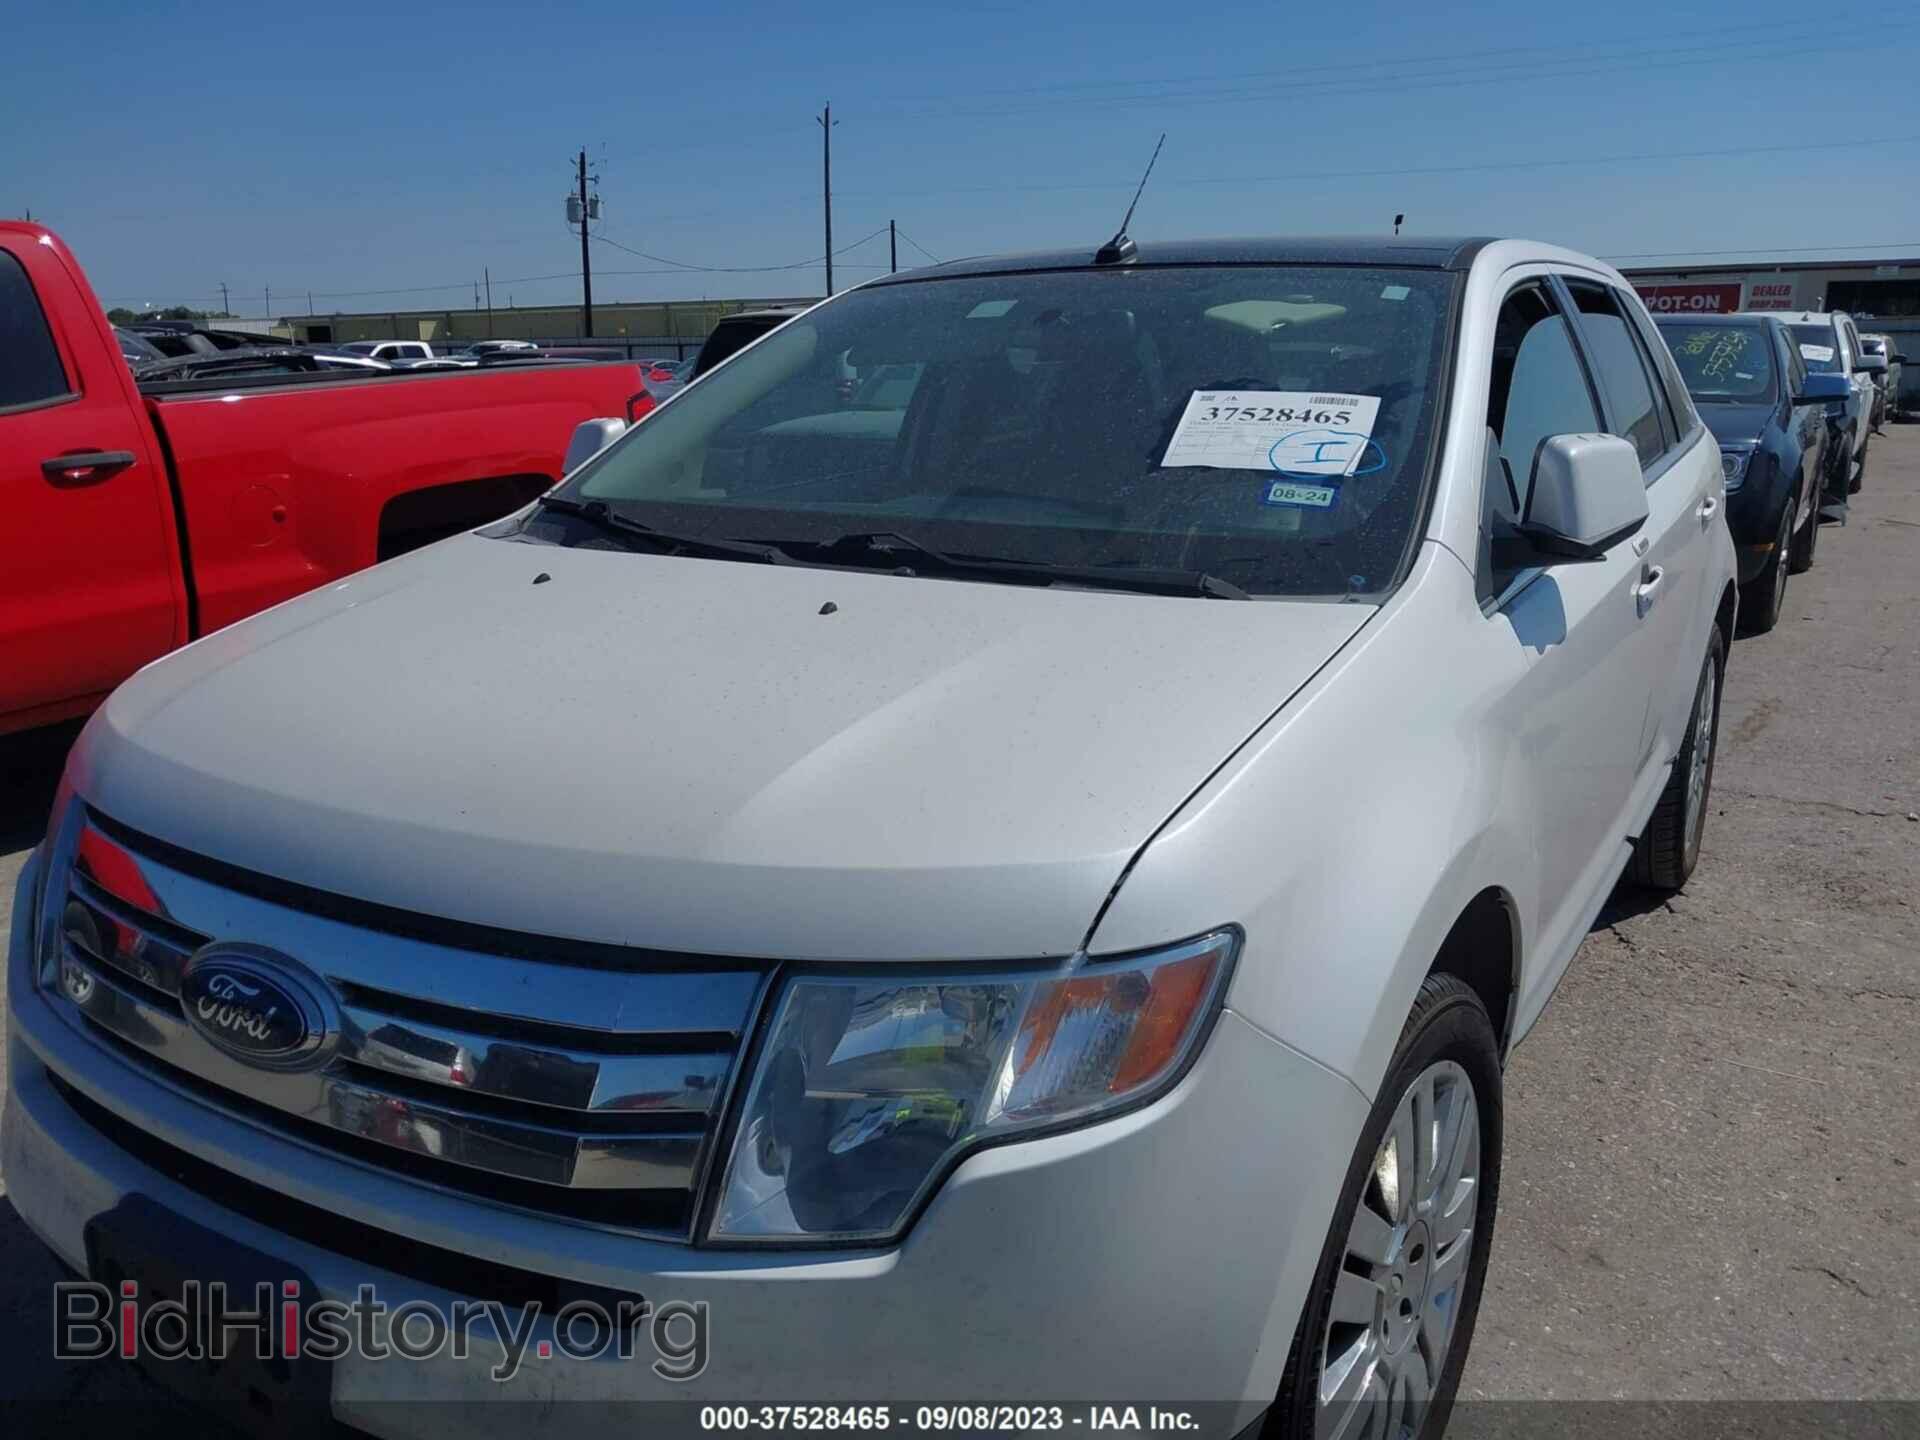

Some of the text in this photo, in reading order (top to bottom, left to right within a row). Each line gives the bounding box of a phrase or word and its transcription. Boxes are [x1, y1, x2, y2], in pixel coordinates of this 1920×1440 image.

[1642, 294, 1720, 310] POT-ON
[1201, 406, 1351, 425] 37528465
[1273, 487, 1329, 502] 08-24
[198, 973, 277, 1040] Ford
